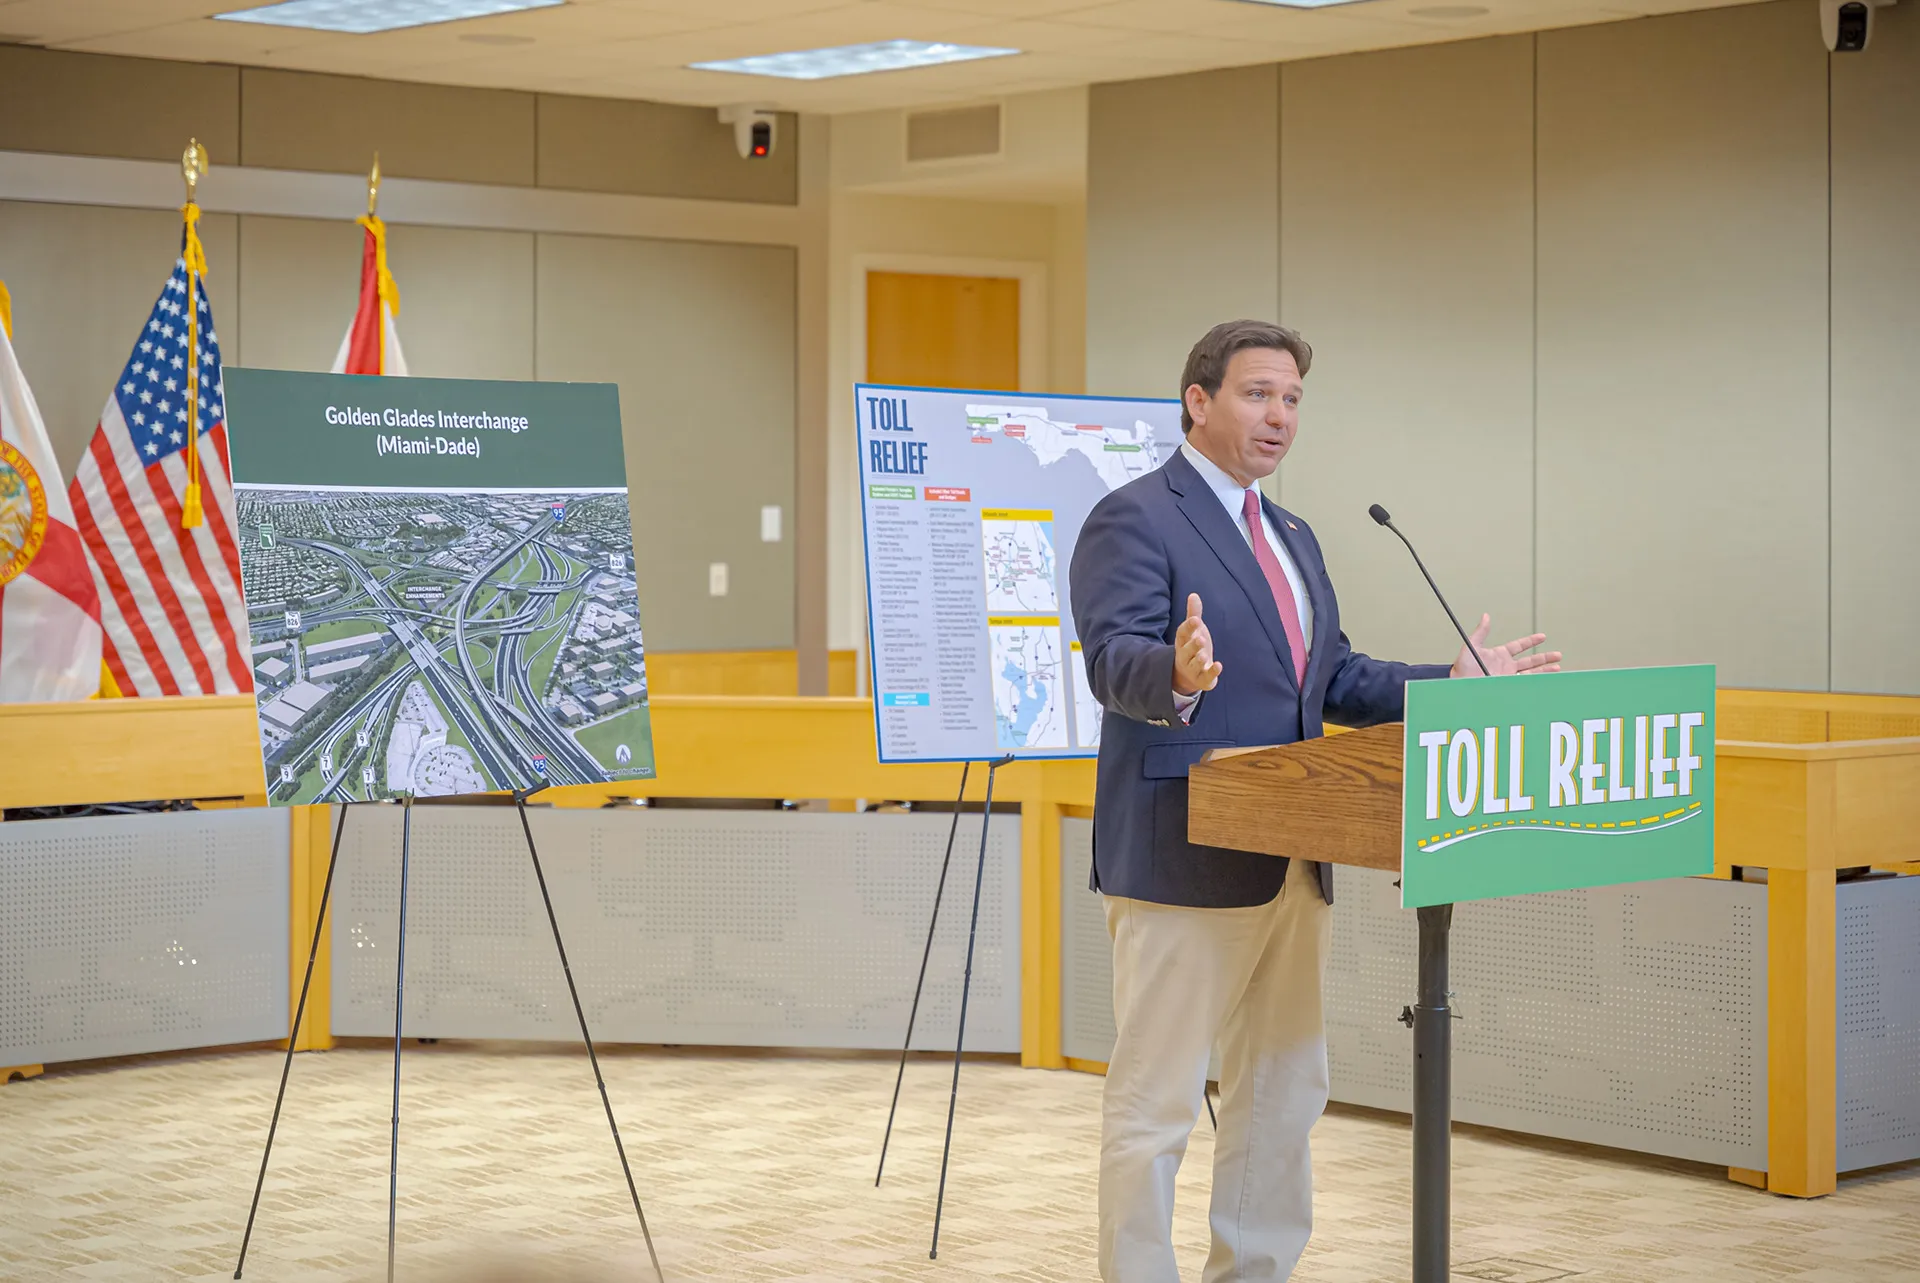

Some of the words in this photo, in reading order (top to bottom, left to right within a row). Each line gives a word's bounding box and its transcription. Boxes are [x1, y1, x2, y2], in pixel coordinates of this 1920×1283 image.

[325, 405, 381, 426] Golden
[383, 408, 436, 428] Glades
[438, 410, 529, 433] Interchange
[866, 397, 914, 432] TOLL
[376, 433, 481, 459] (Miami-Dade)
[869, 439, 929, 475] RELIEF
[553, 508, 564, 518] 95
[534, 760, 545, 769] 95
[1418, 724, 1535, 820] TOLL
[1548, 711, 1705, 808] RELIEF
